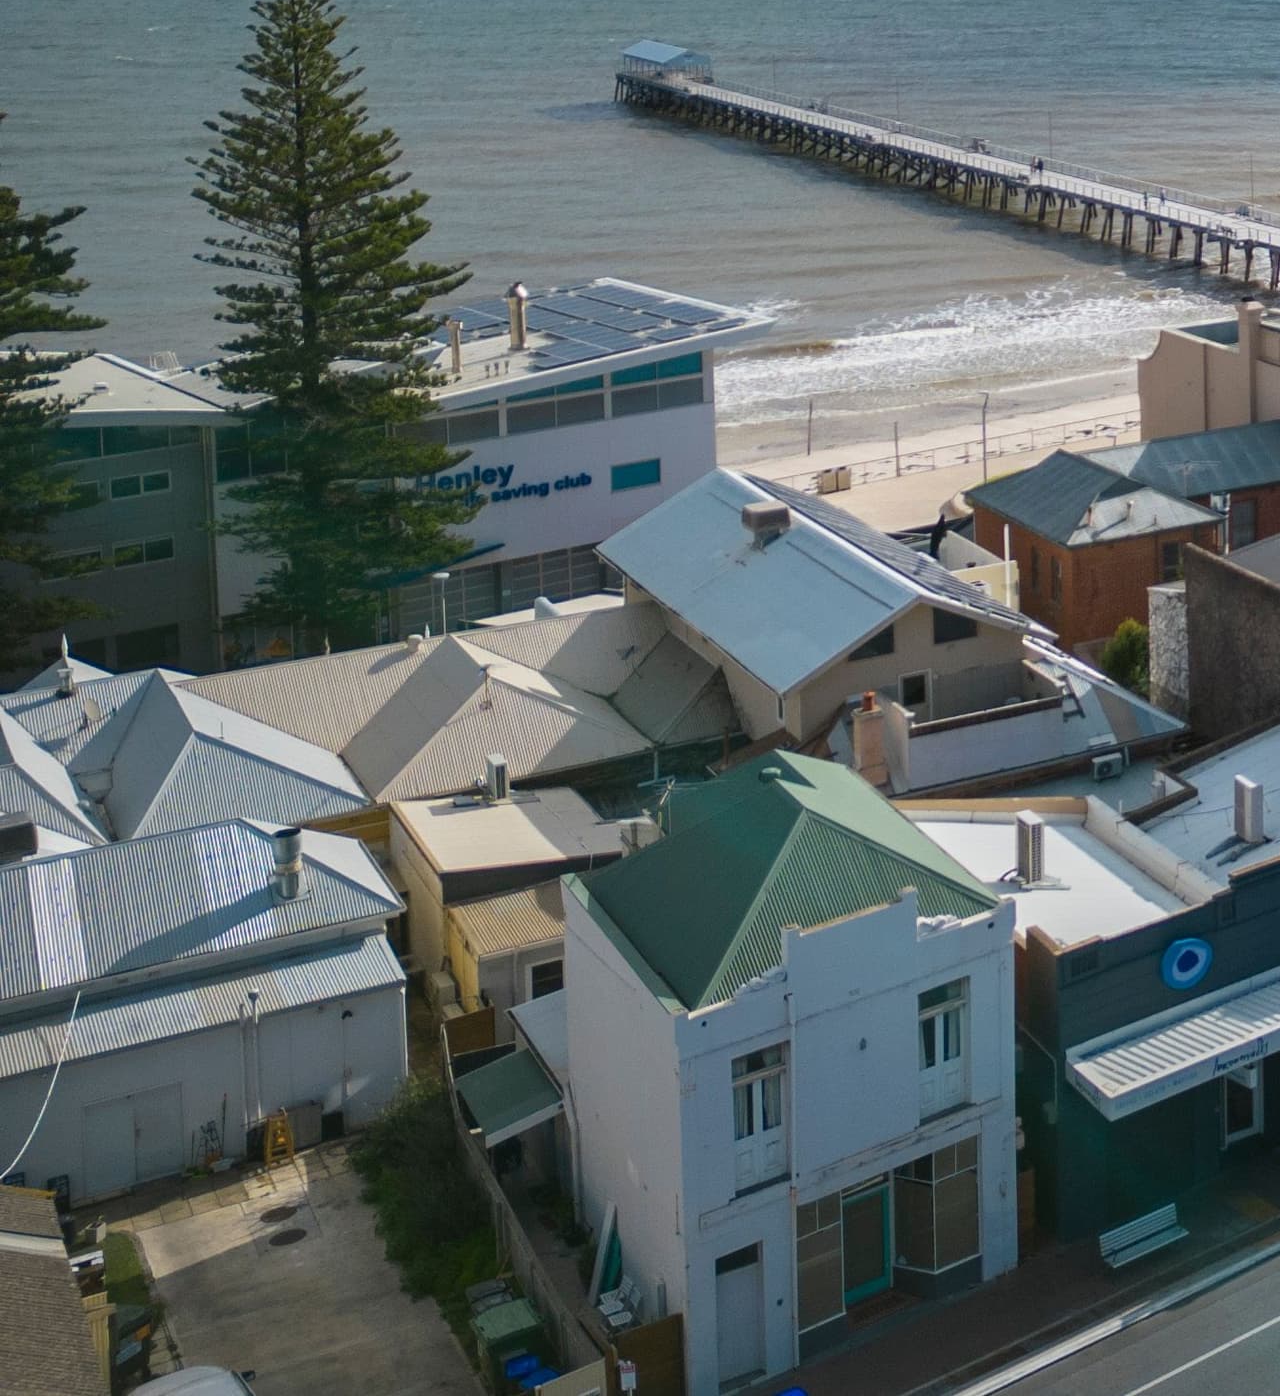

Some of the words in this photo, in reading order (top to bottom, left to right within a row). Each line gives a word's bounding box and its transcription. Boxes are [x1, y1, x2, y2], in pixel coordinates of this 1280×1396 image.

[416, 463, 515, 491] Henley
[491, 480, 550, 503] saving
[553, 471, 592, 492] club
